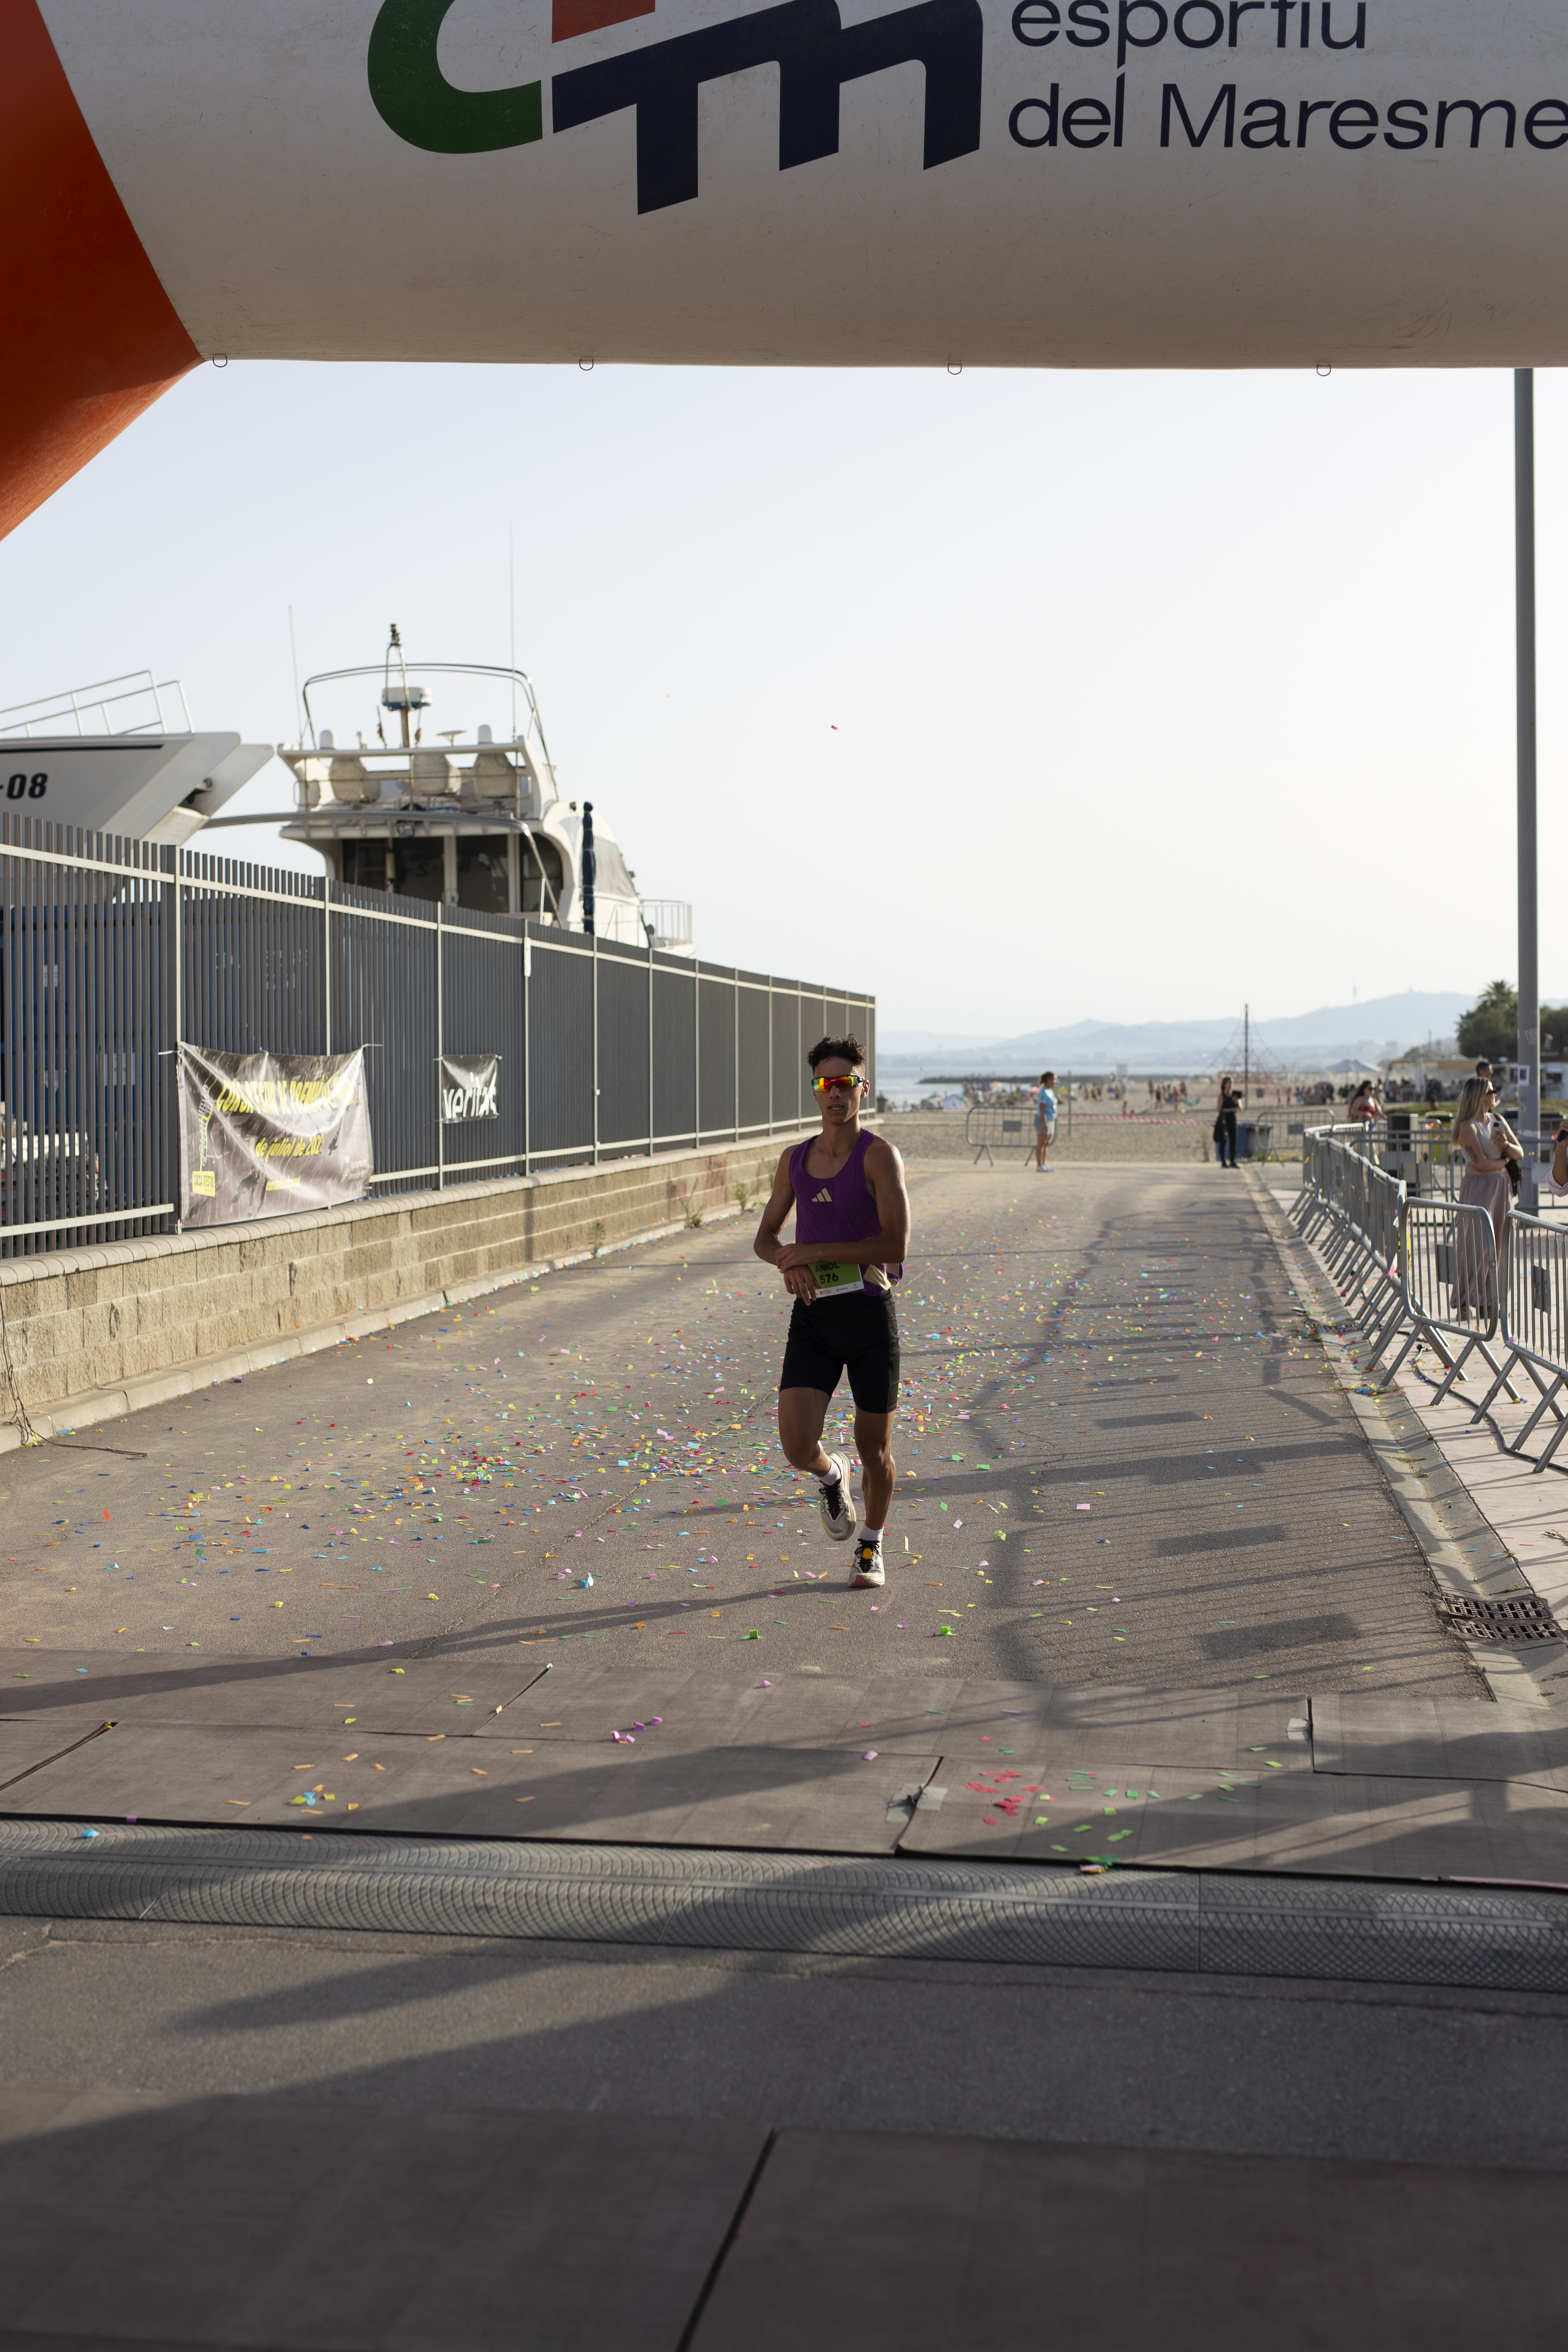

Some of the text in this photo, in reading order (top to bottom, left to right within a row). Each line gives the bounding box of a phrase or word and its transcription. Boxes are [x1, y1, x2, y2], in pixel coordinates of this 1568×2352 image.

[1008, 71, 1568, 149] del Maresme
[443, 1072, 496, 1119] veritas
[255, 1137, 268, 1157] de
[265, 1137, 297, 1163] juliol
[293, 1136, 306, 1157] de
[305, 1134, 323, 1156] 202
[815, 1262, 840, 1273] ANIOL
[819, 1273, 839, 1284] 576
